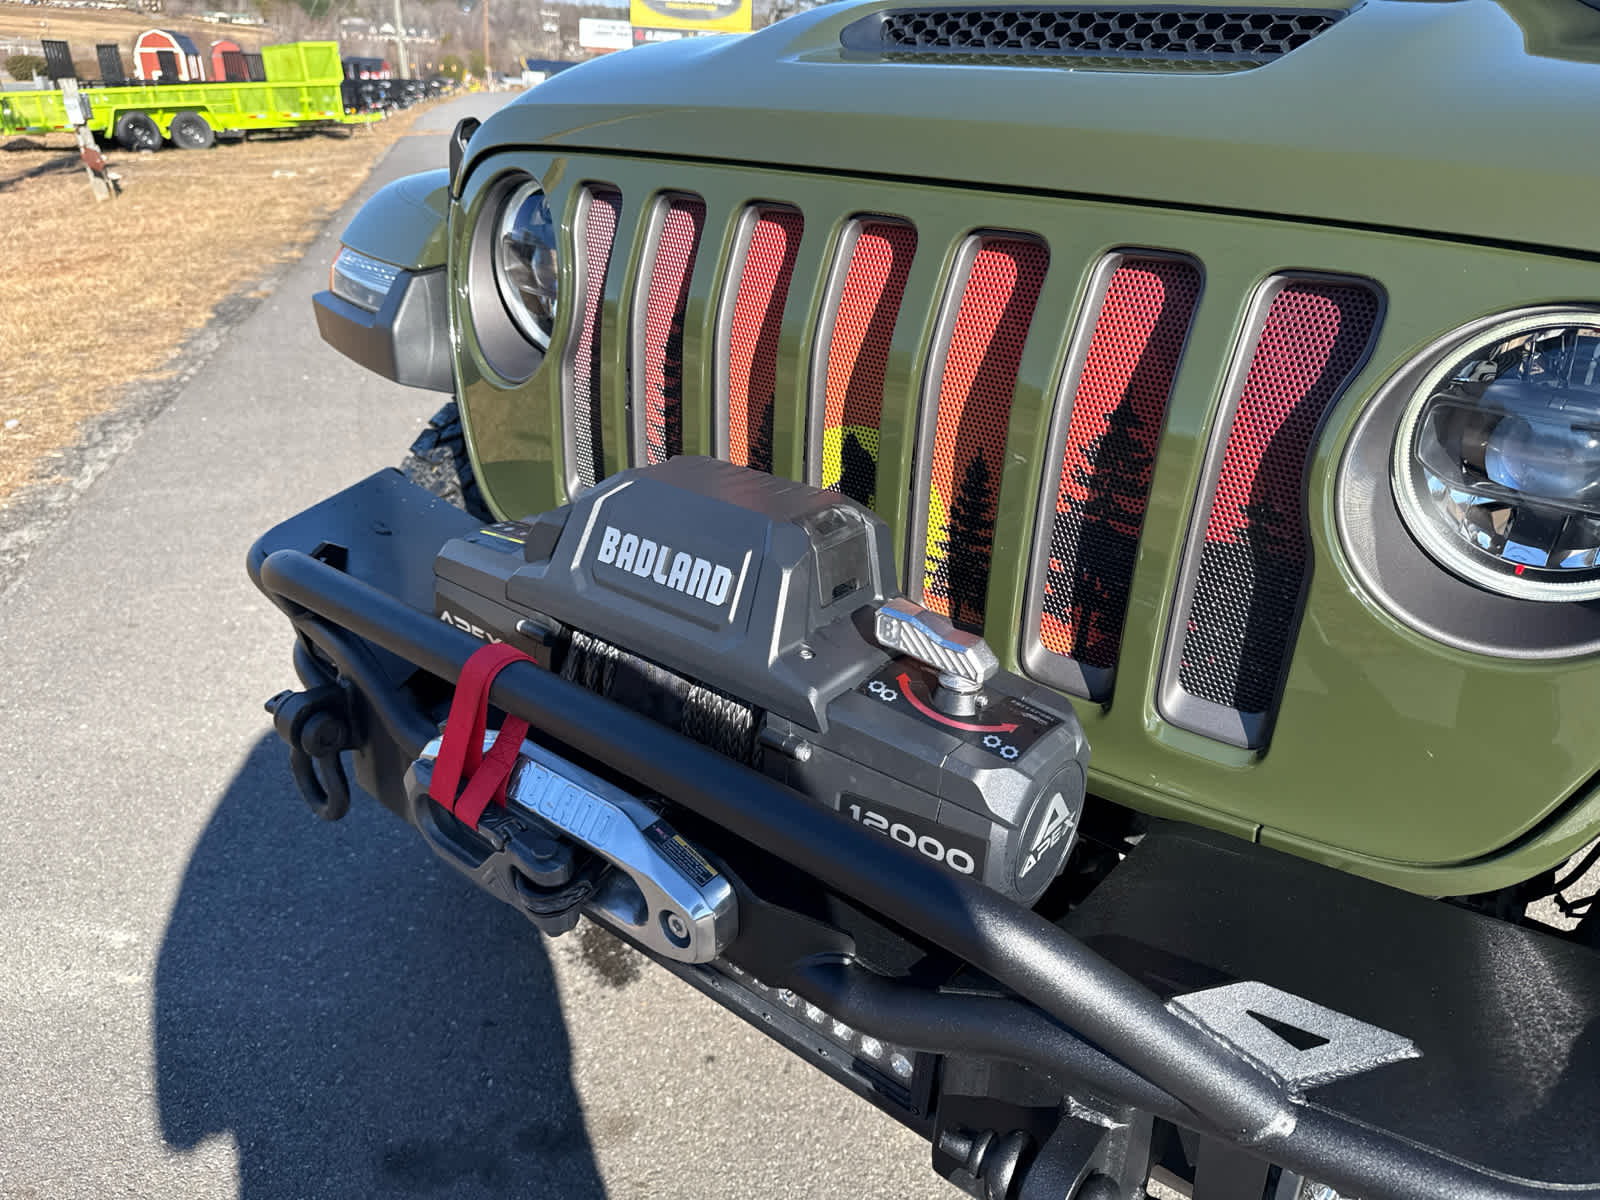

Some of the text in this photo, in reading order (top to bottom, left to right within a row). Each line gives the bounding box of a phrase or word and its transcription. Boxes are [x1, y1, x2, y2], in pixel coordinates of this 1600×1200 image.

[597, 525, 733, 607] BADLAND
[849, 804, 975, 875] 12000
[1019, 810, 1077, 878] APEX
